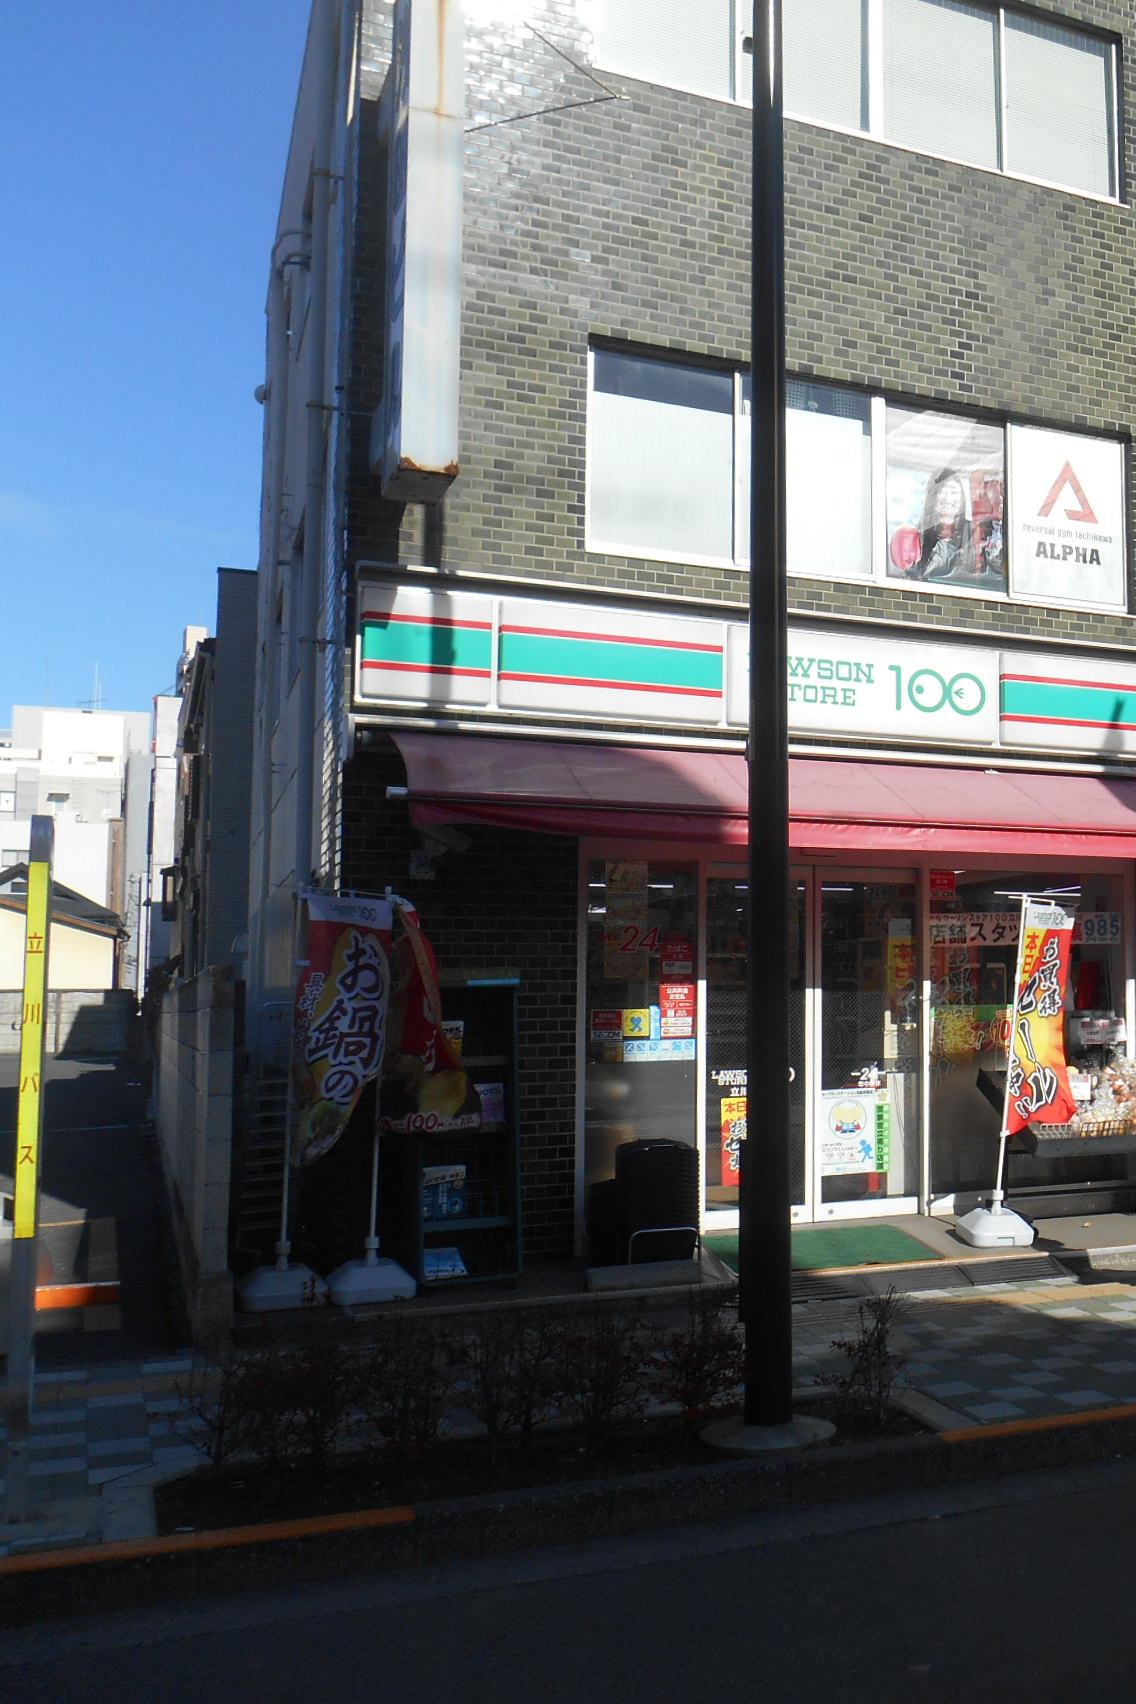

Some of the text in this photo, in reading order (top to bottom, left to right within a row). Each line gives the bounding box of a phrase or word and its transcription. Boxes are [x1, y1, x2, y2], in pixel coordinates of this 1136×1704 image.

[1022, 523, 1113, 544] reversal gym tachikawa
[1035, 541, 1102, 566] ALPHA
[747, 652, 986, 716] WSON 100
[788, 684, 856, 706] TORE
[619, 926, 661, 952] 24
[1084, 919, 1120, 937] 985
[1022, 932, 1039, 974] 本日
[1037, 936, 1063, 1017] お買得
[311, 938, 384, 1098] お鍋の
[18, 934, 44, 1166] 立川バス
[711, 1070, 747, 1079] LAWS
